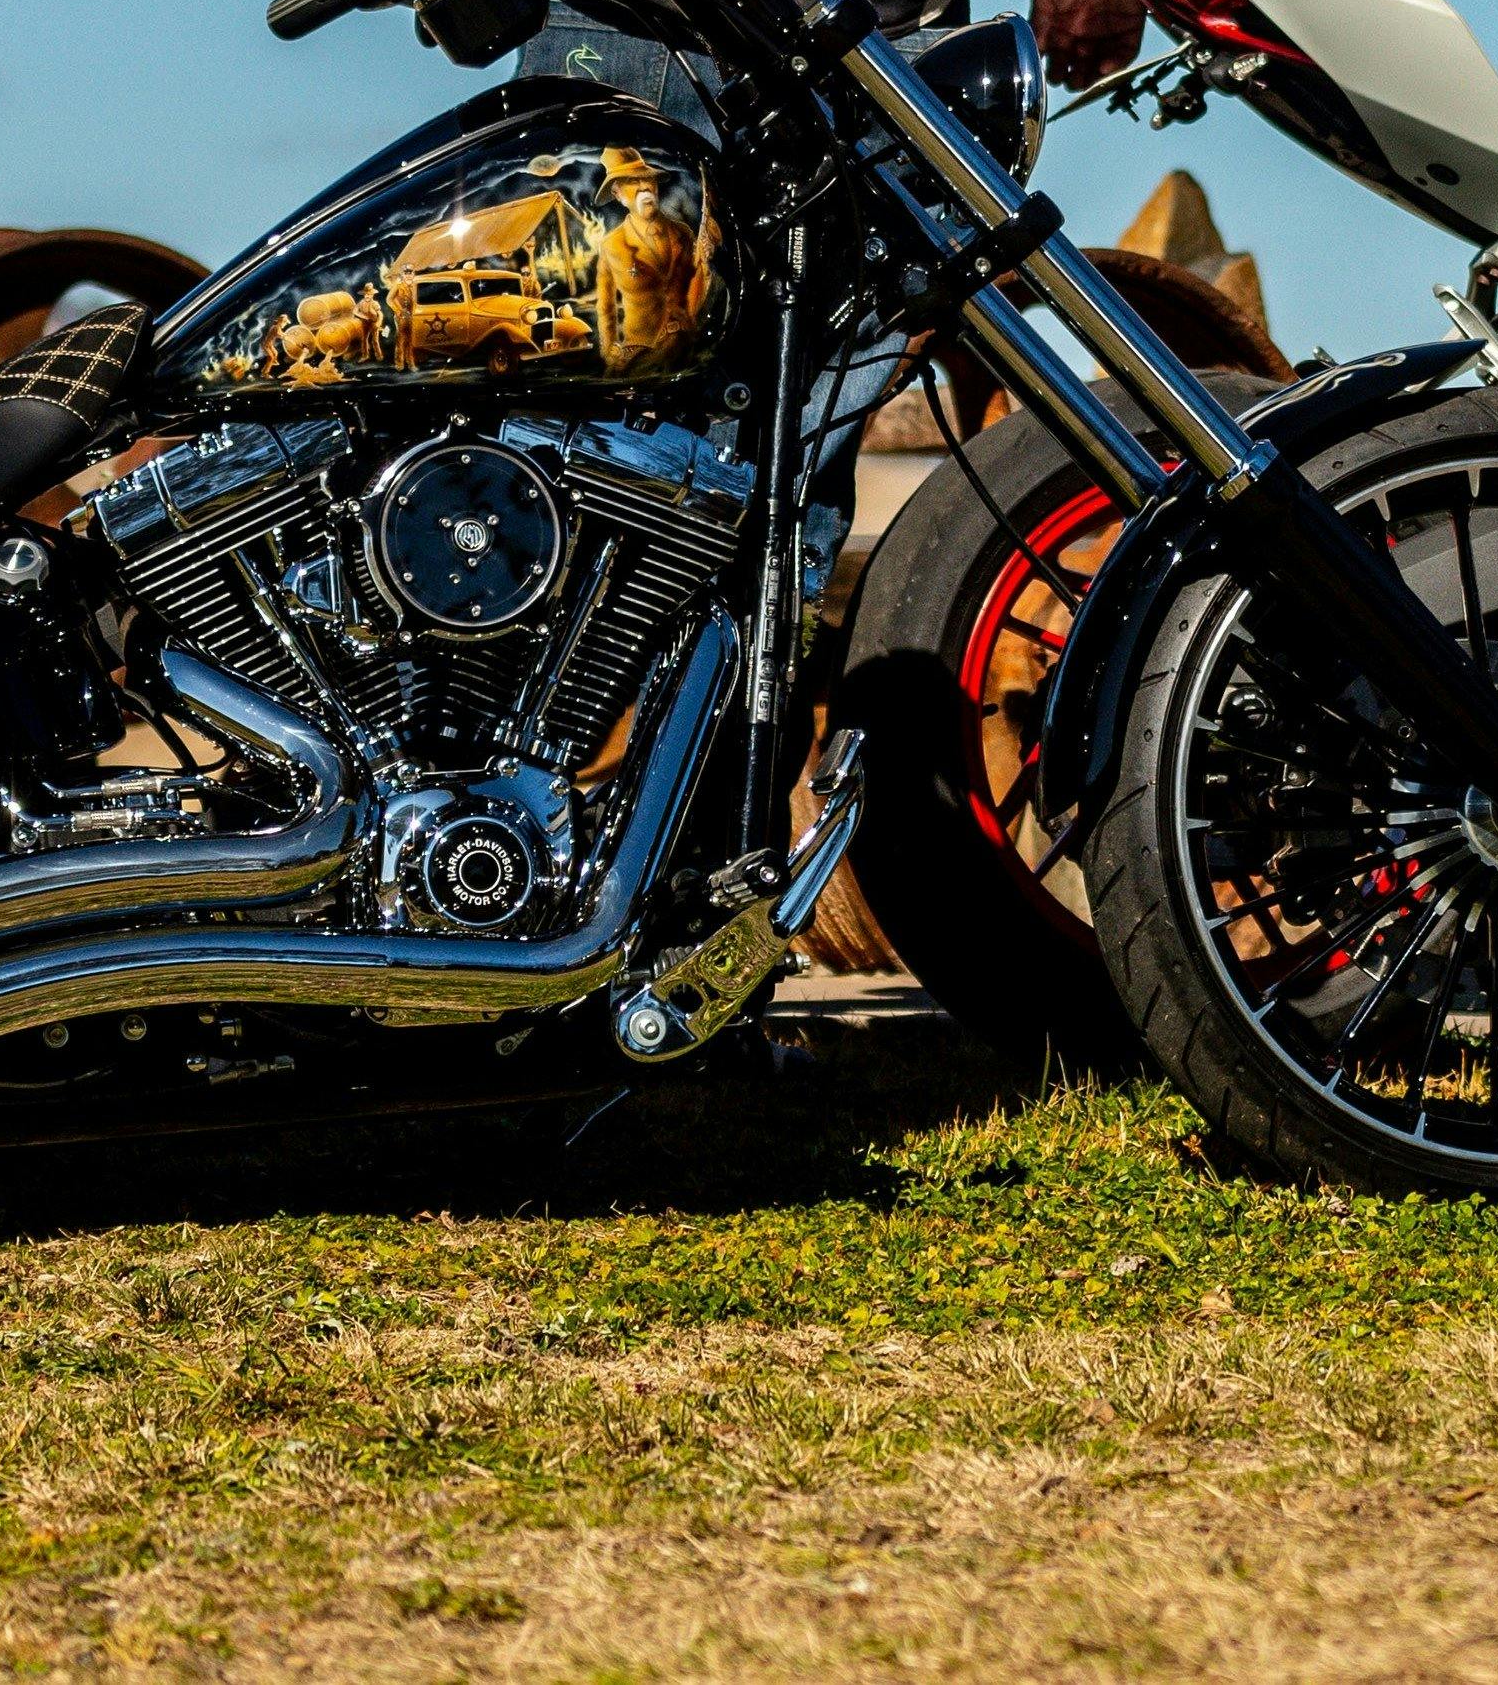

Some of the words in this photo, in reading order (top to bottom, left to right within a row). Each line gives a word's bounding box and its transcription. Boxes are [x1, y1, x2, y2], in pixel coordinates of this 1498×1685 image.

[446, 838, 514, 882] HARLEY-DAVIDSON
[452, 884, 491, 906] MOTOR
[492, 885, 510, 901] CO.
